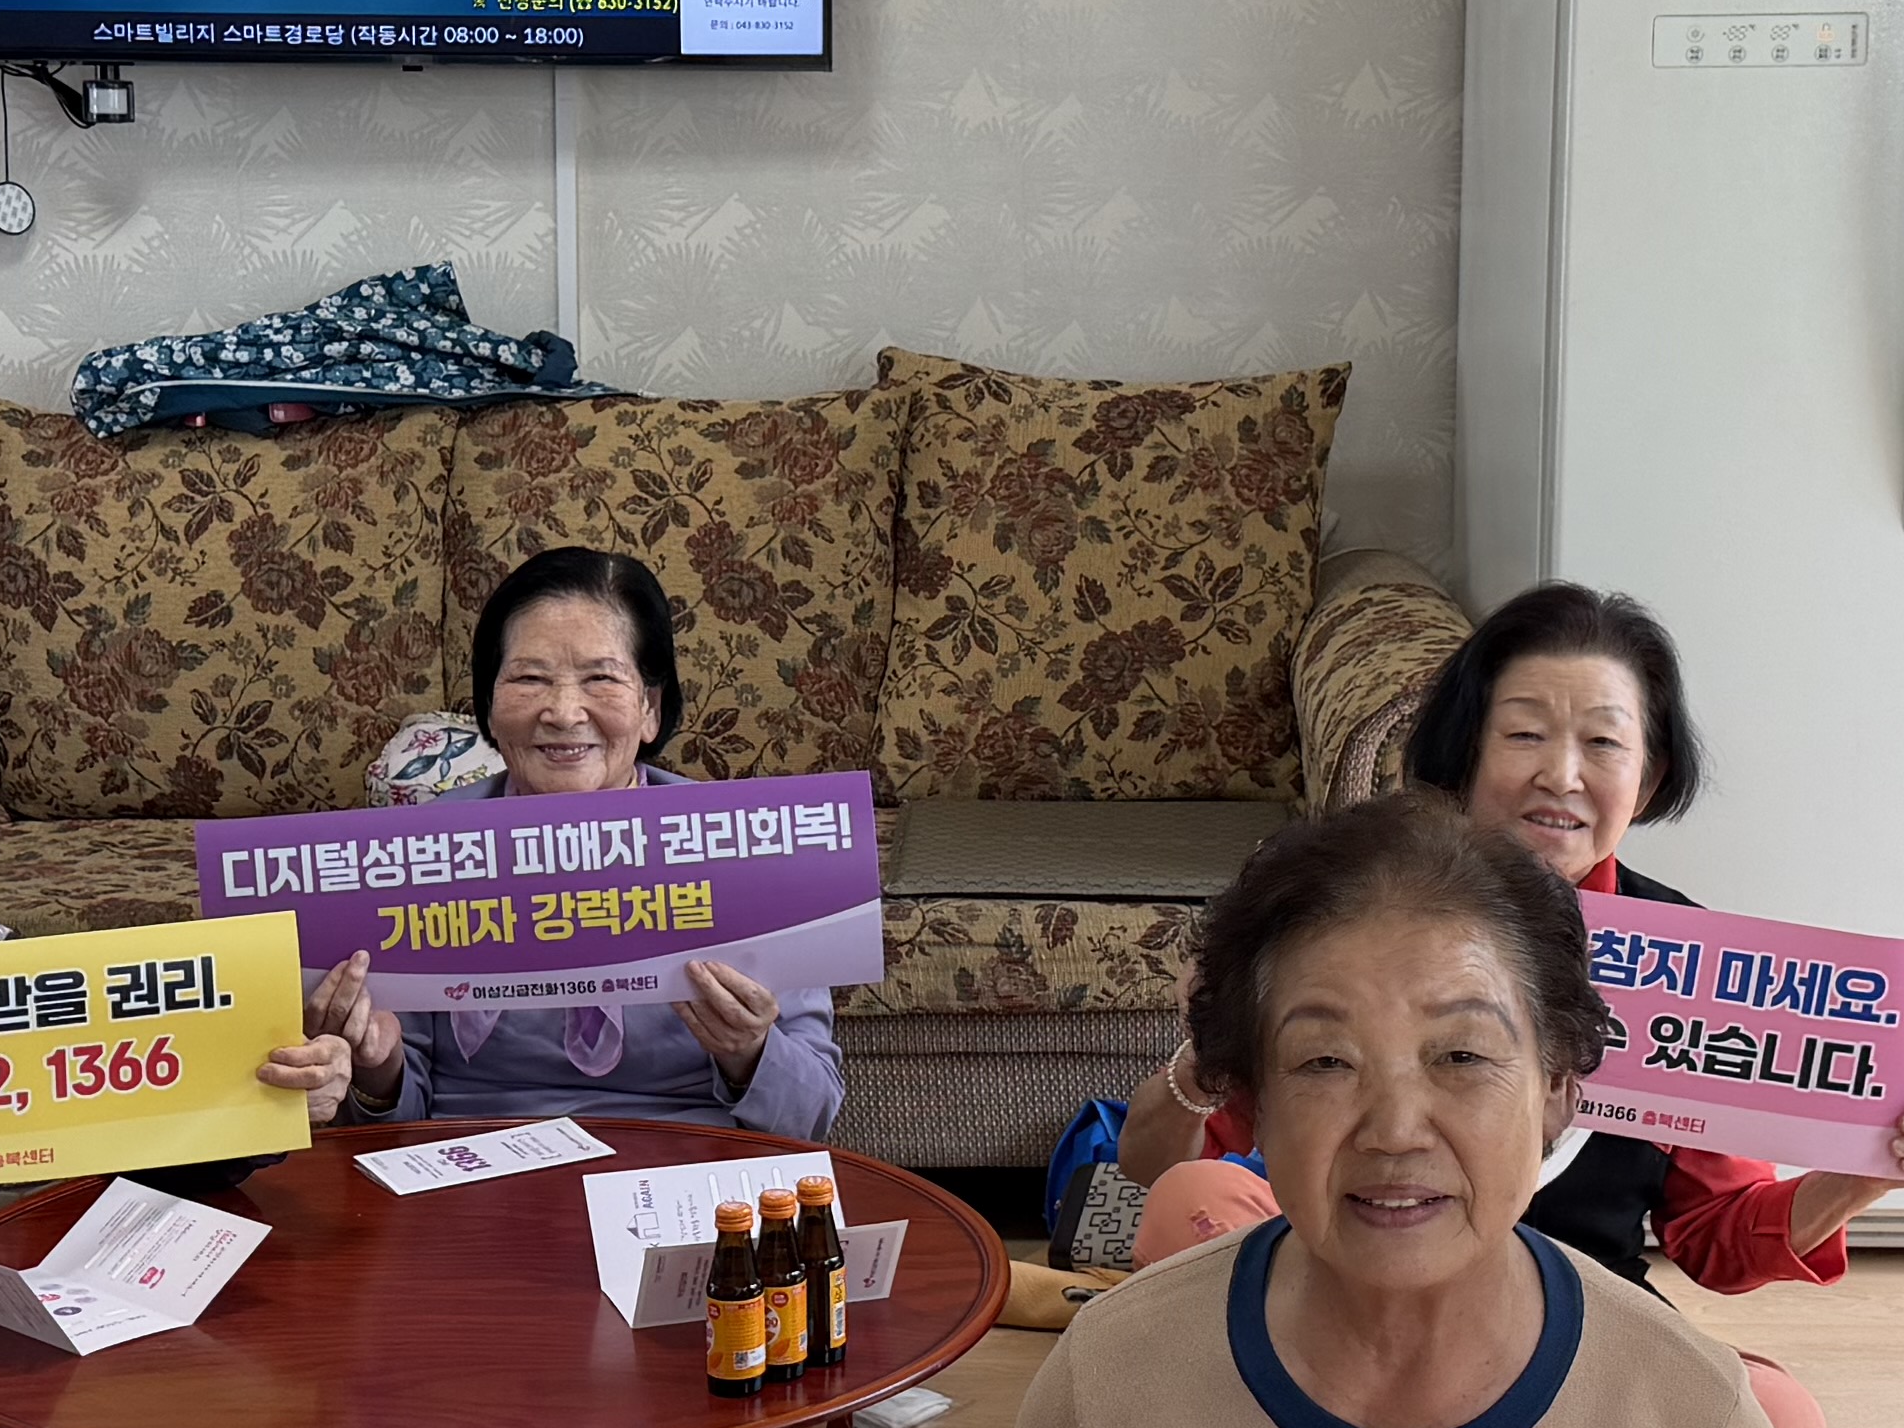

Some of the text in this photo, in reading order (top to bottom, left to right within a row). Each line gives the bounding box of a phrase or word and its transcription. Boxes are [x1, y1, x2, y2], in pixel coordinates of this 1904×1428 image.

[93, 22, 584, 49] 스마트빌리지 스마트경로당 (작동시간 08:00 18:00)
[222, 802, 852, 898] 디지털성범죄 피해자 권리회복!
[377, 880, 714, 952] 가해자 강력처벌
[105, 954, 234, 1020] 권리.
[471, 975, 658, 1001] 여성긴급전화1366 충북센터
[1589, 929, 1899, 1028] 참지 마세요.
[46, 1035, 181, 1101] 1366
[1644, 1015, 1885, 1101] 있습니다.
[1641, 1109, 1705, 1134] 충북센터
[642, 1179, 655, 1209] AGAIN
